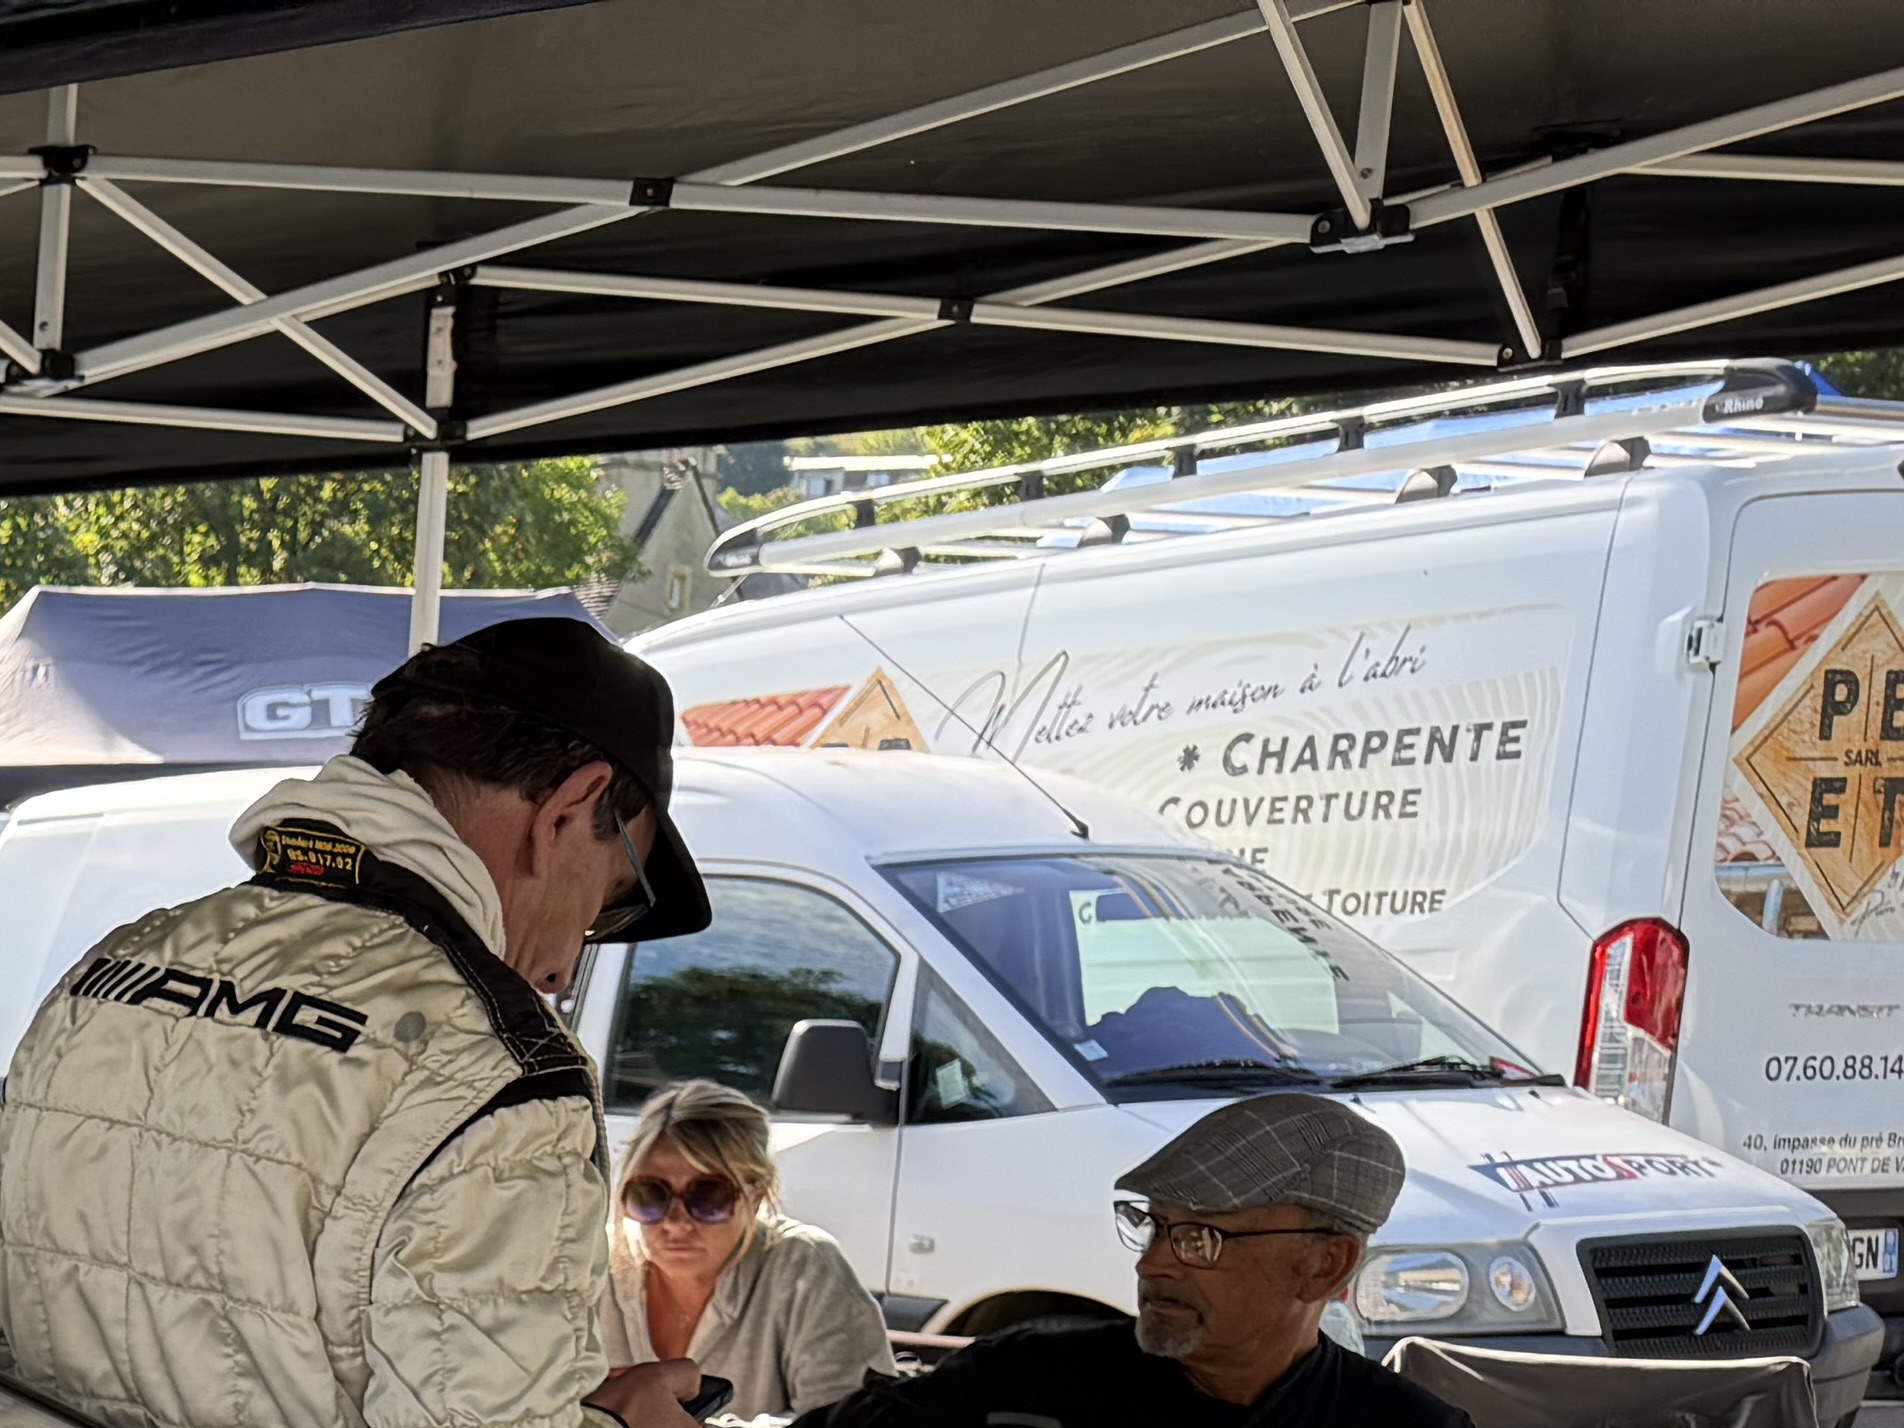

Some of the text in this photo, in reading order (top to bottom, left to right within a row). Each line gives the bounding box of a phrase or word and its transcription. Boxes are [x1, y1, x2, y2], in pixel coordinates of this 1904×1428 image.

[934, 649, 1095, 764] Mettez
[1108, 672, 1175, 731] votre
[1188, 679, 1286, 714] maison
[1222, 719, 1528, 777] CHARPENTE
[1844, 749, 1882, 767] SARL
[1322, 889, 1448, 916] TOITURE
[1789, 1003, 1901, 1018] TRANSIT
[1773, 1132, 1836, 1152] impasse
[1839, 1132, 1857, 1148] du
[1826, 1156, 1869, 1174] PONT
[1871, 1156, 1891, 1173] DE
